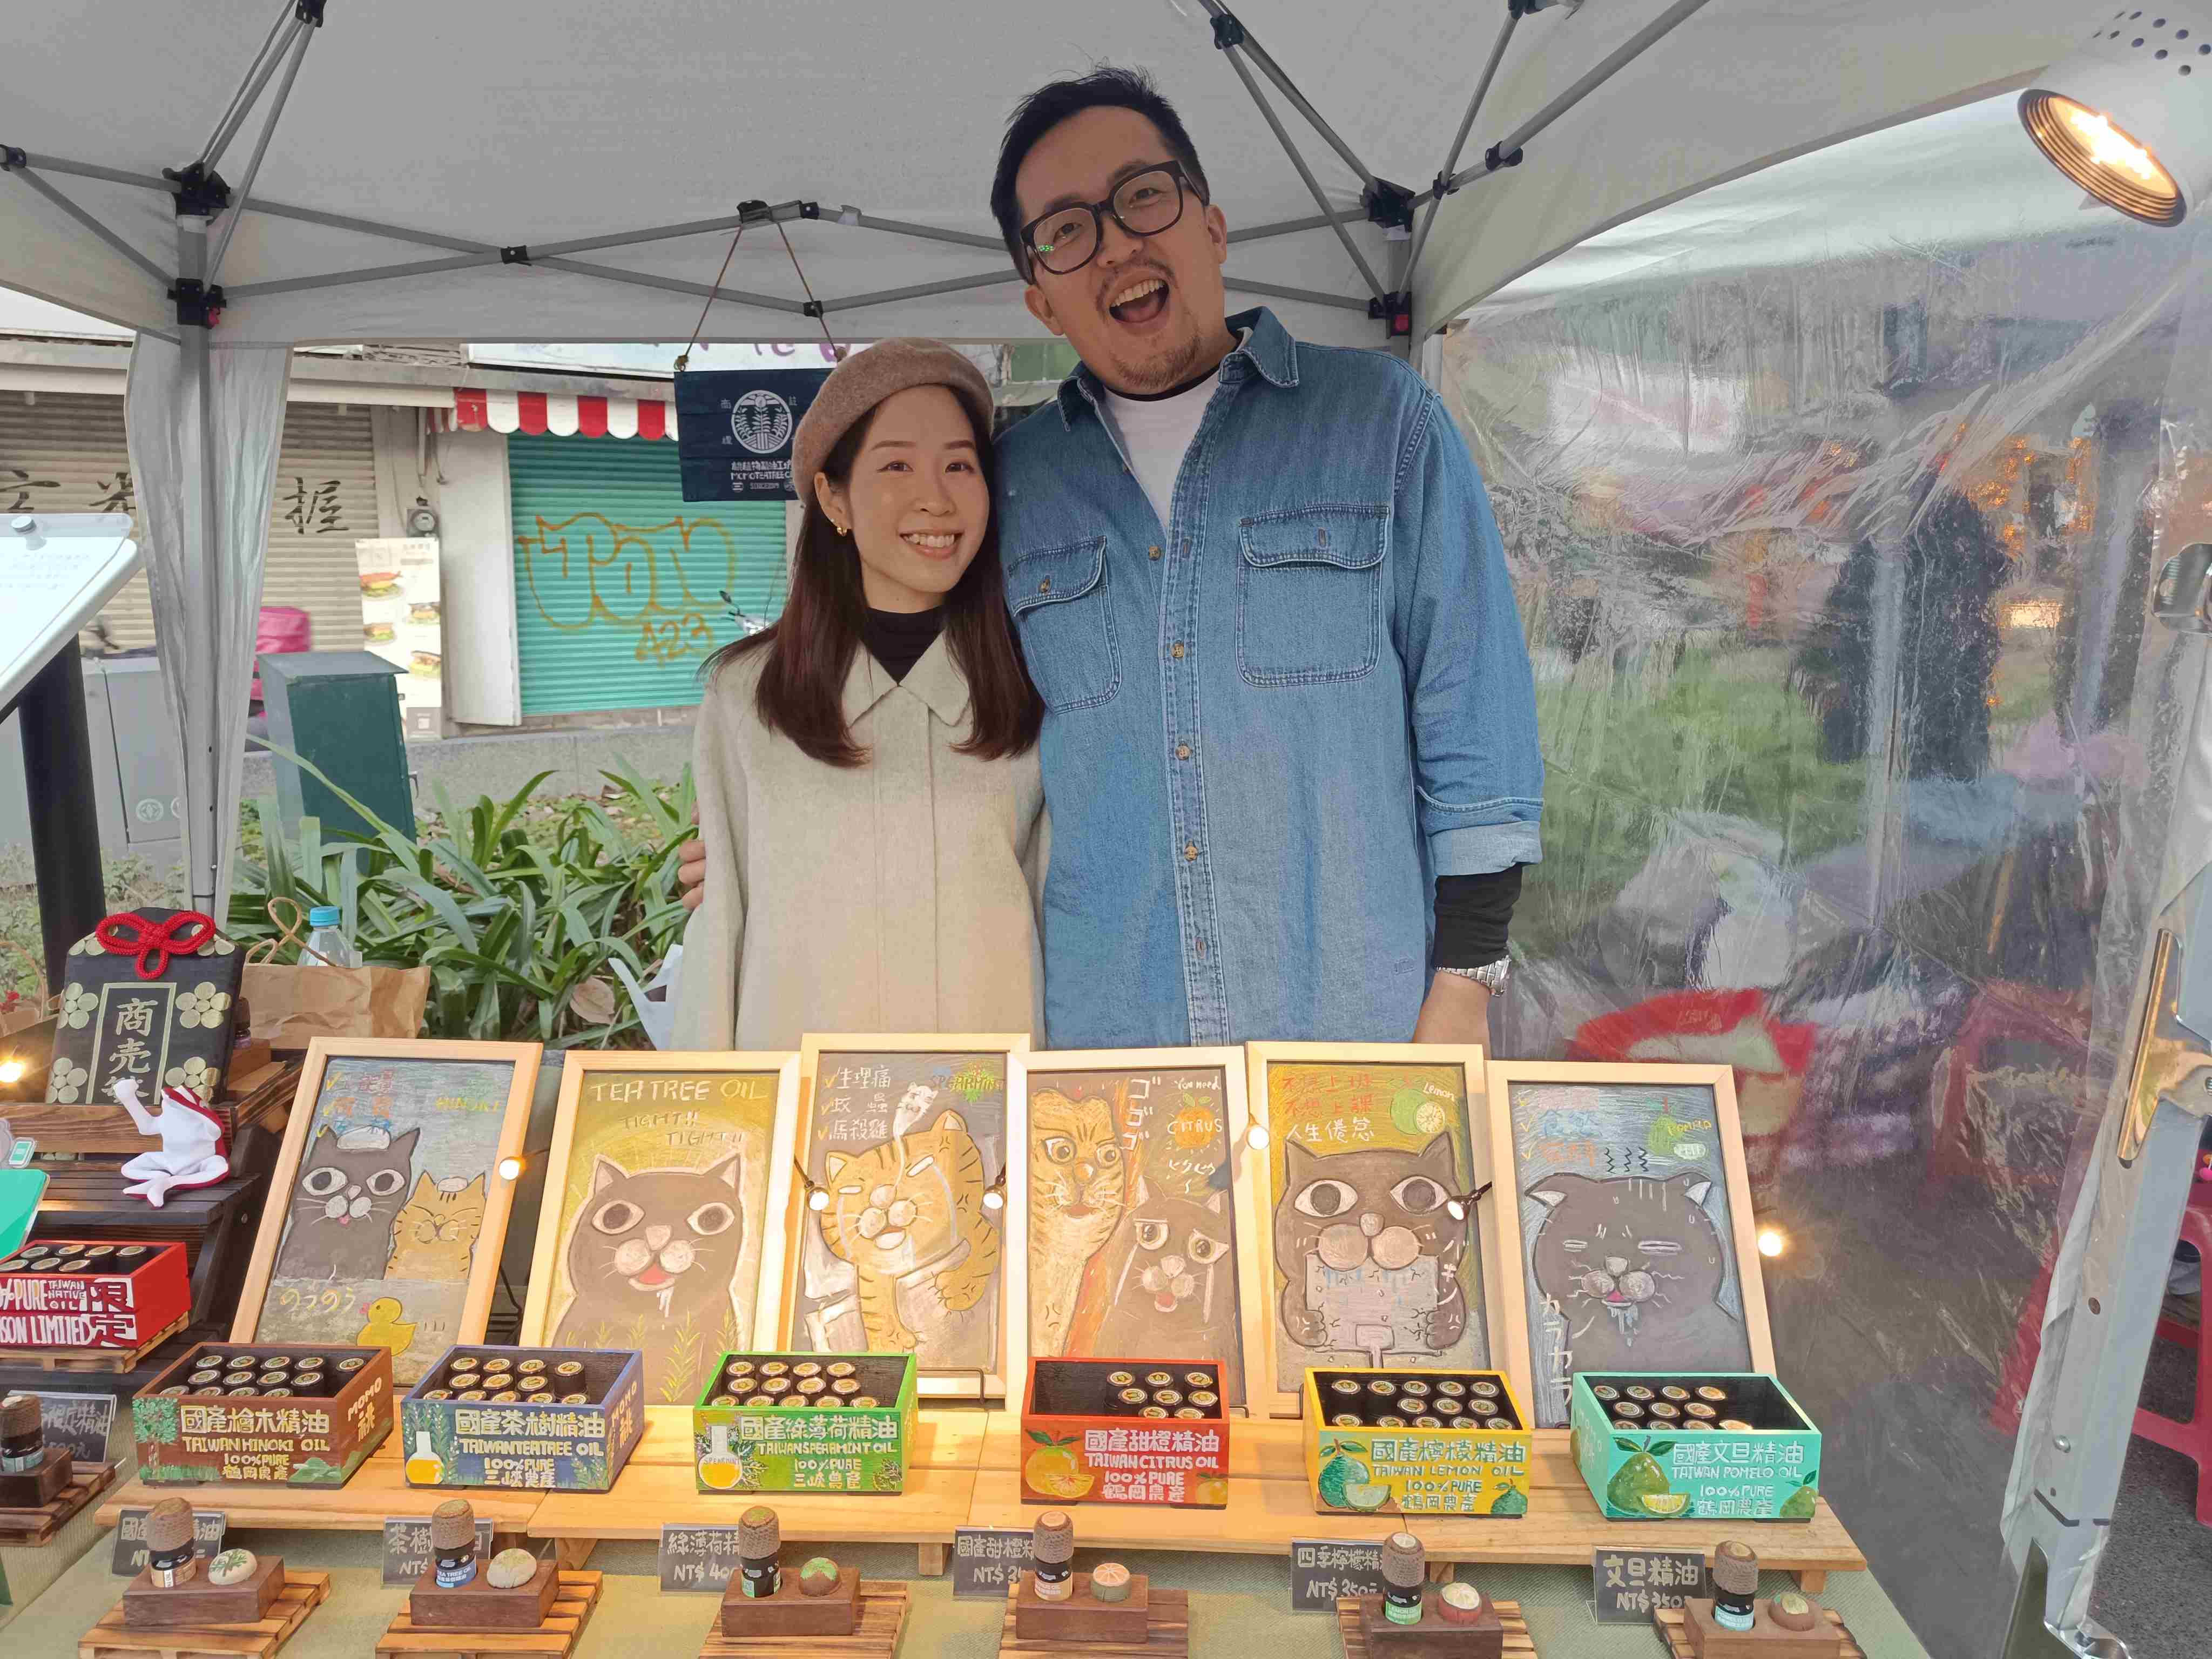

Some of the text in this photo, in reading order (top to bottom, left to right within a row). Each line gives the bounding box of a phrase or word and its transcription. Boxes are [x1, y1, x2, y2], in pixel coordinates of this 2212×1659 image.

[835, 1065, 891, 1089] 生理痛
[1167, 1118, 1223, 1135] CITRUS
[30, 1315, 93, 1345] LIMITED
[241, 1437, 294, 1452] HINOKI
[301, 1439, 331, 1452] OIL
[575, 1443, 604, 1457] OIL
[1084, 1453, 1219, 1469] TAIWAN CITRUS OIL
[1373, 1464, 1525, 1477] TAIWAN LEMON OIL
[1671, 1466, 1803, 1480] TAIWAN POMELO OIL
[1450, 1480, 1483, 1493] PURE
[1742, 1484, 1776, 1498] PURE
[1603, 1554, 1698, 1587] 文旦精油
